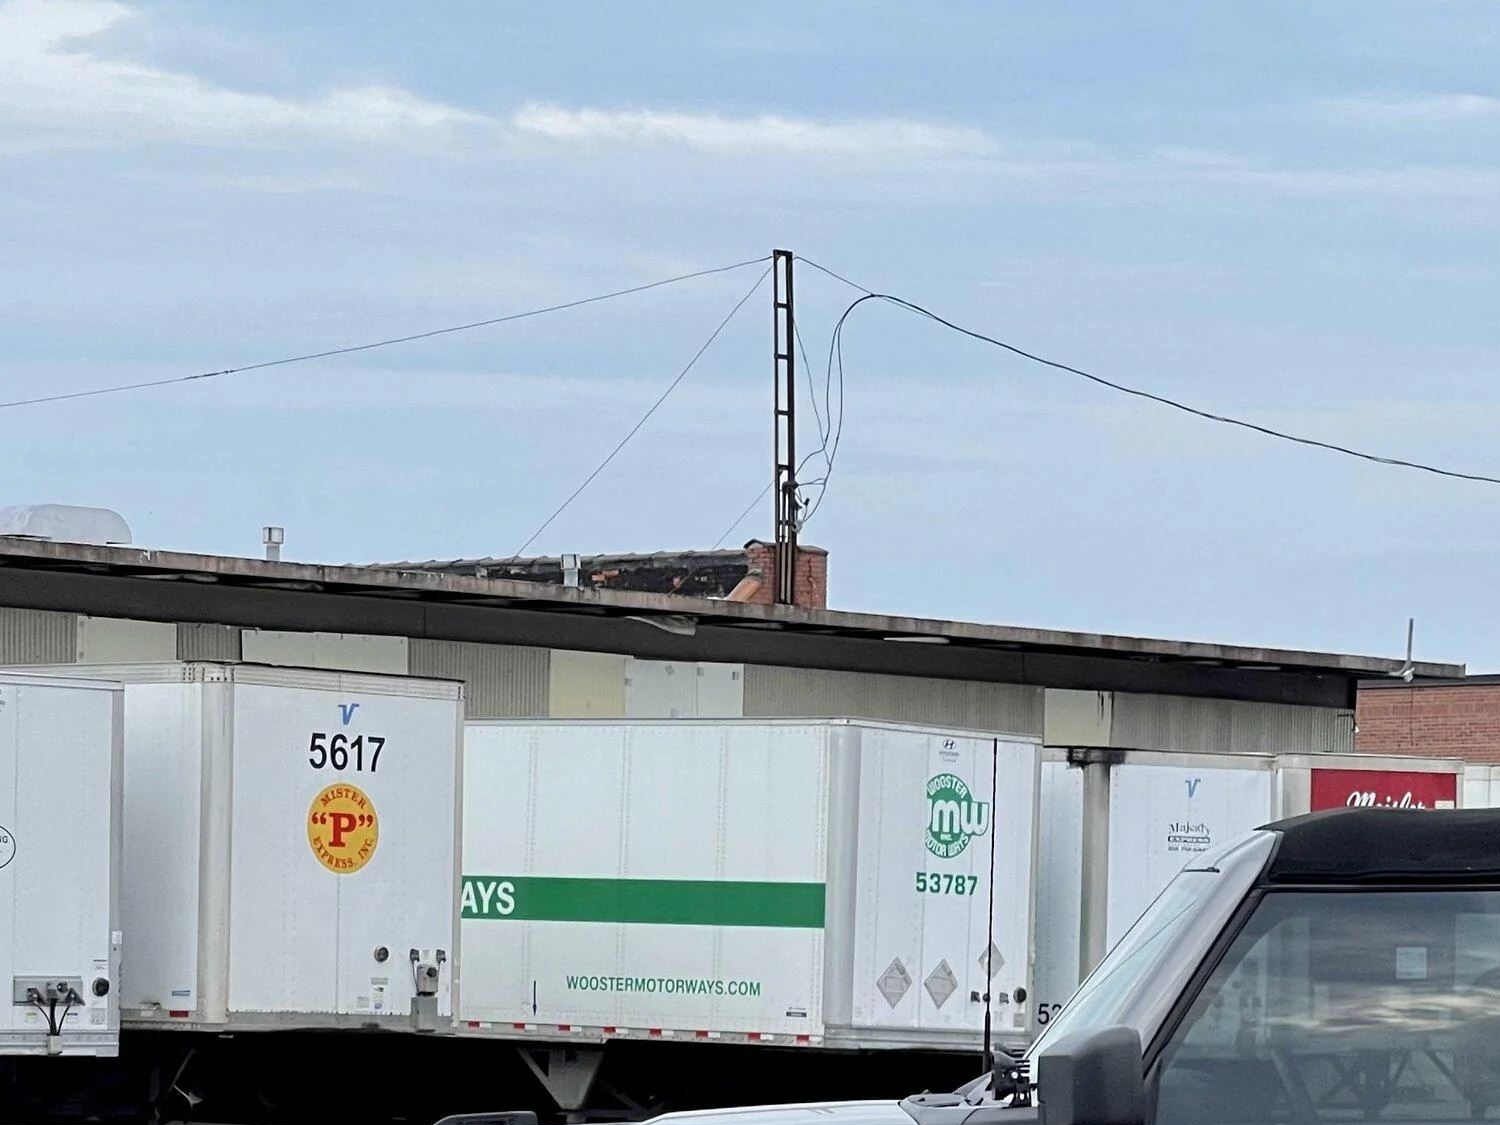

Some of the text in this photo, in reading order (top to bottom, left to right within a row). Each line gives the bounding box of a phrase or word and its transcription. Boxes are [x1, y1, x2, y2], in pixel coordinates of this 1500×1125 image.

[309, 732, 386, 772] 5617
[320, 787, 367, 809] MISTER
[927, 775, 968, 799] WOOSTER
[916, 872, 978, 896] 53787
[461, 881, 515, 915] AYS
[566, 975, 761, 996] WOOSTERMOTORWAYS.COM
